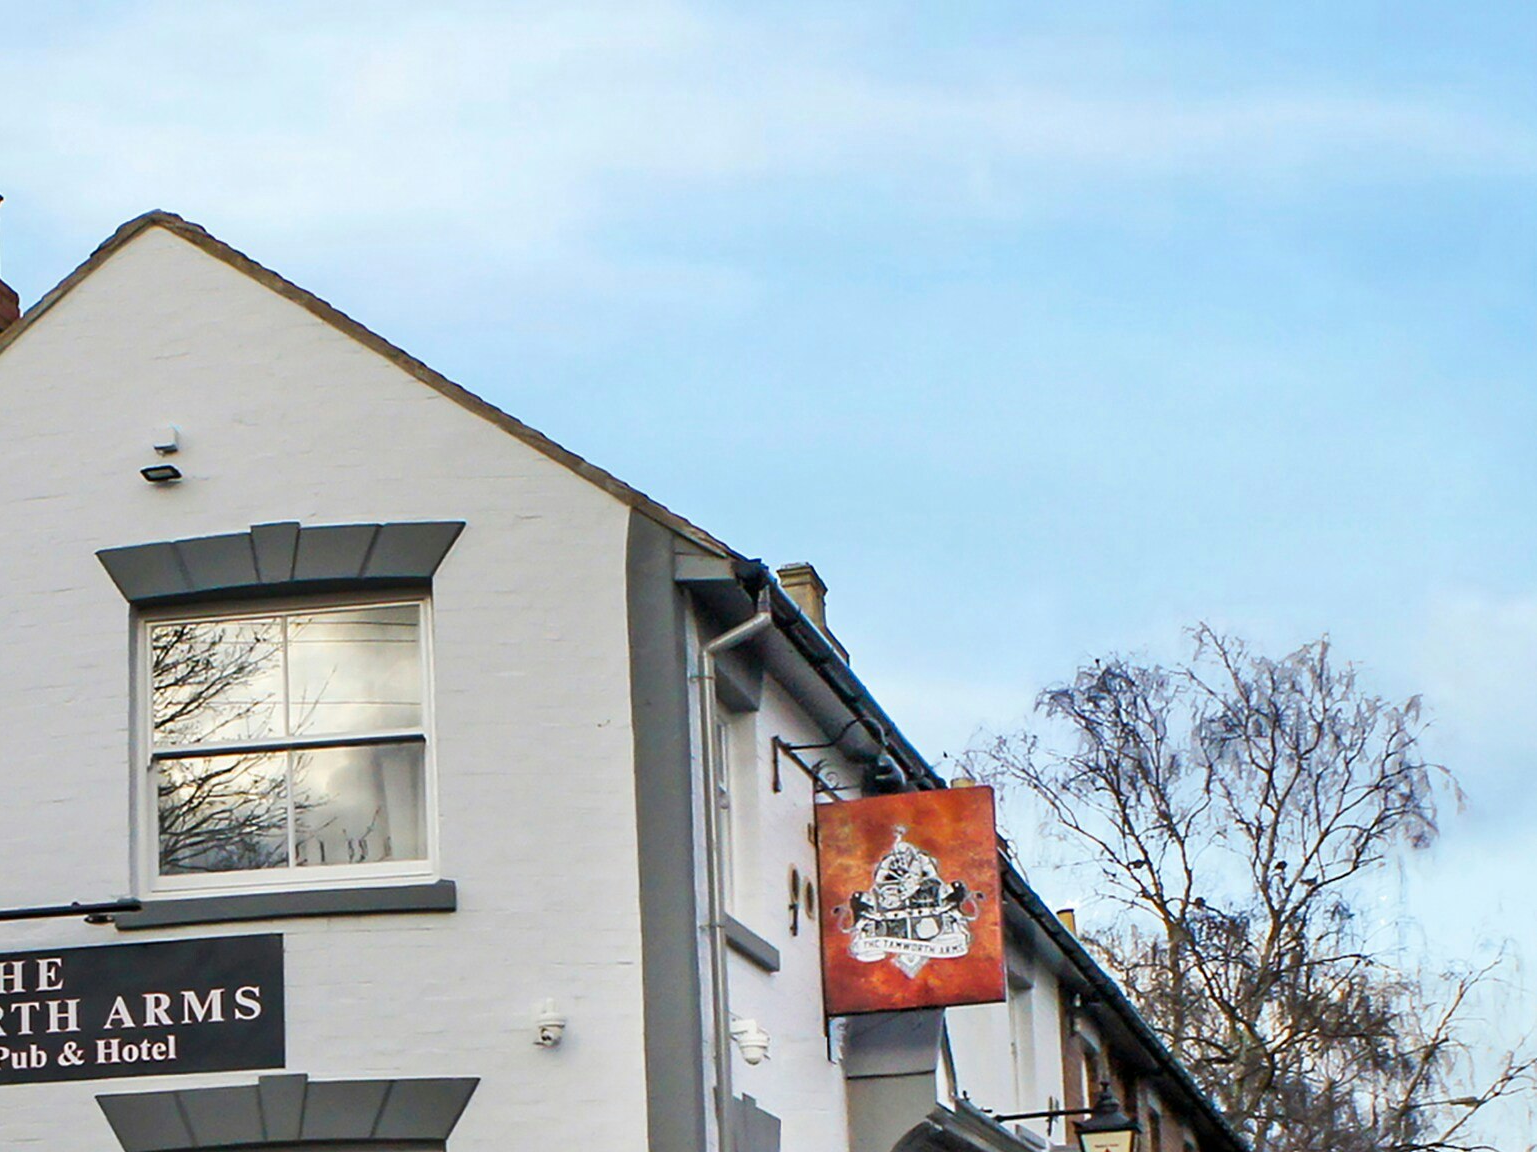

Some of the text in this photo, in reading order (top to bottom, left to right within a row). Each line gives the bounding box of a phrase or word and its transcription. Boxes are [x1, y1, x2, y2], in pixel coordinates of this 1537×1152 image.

[103, 986, 262, 1030] ARMS
[57, 1040, 85, 1067] &
[95, 1035, 177, 1065] Hotel
